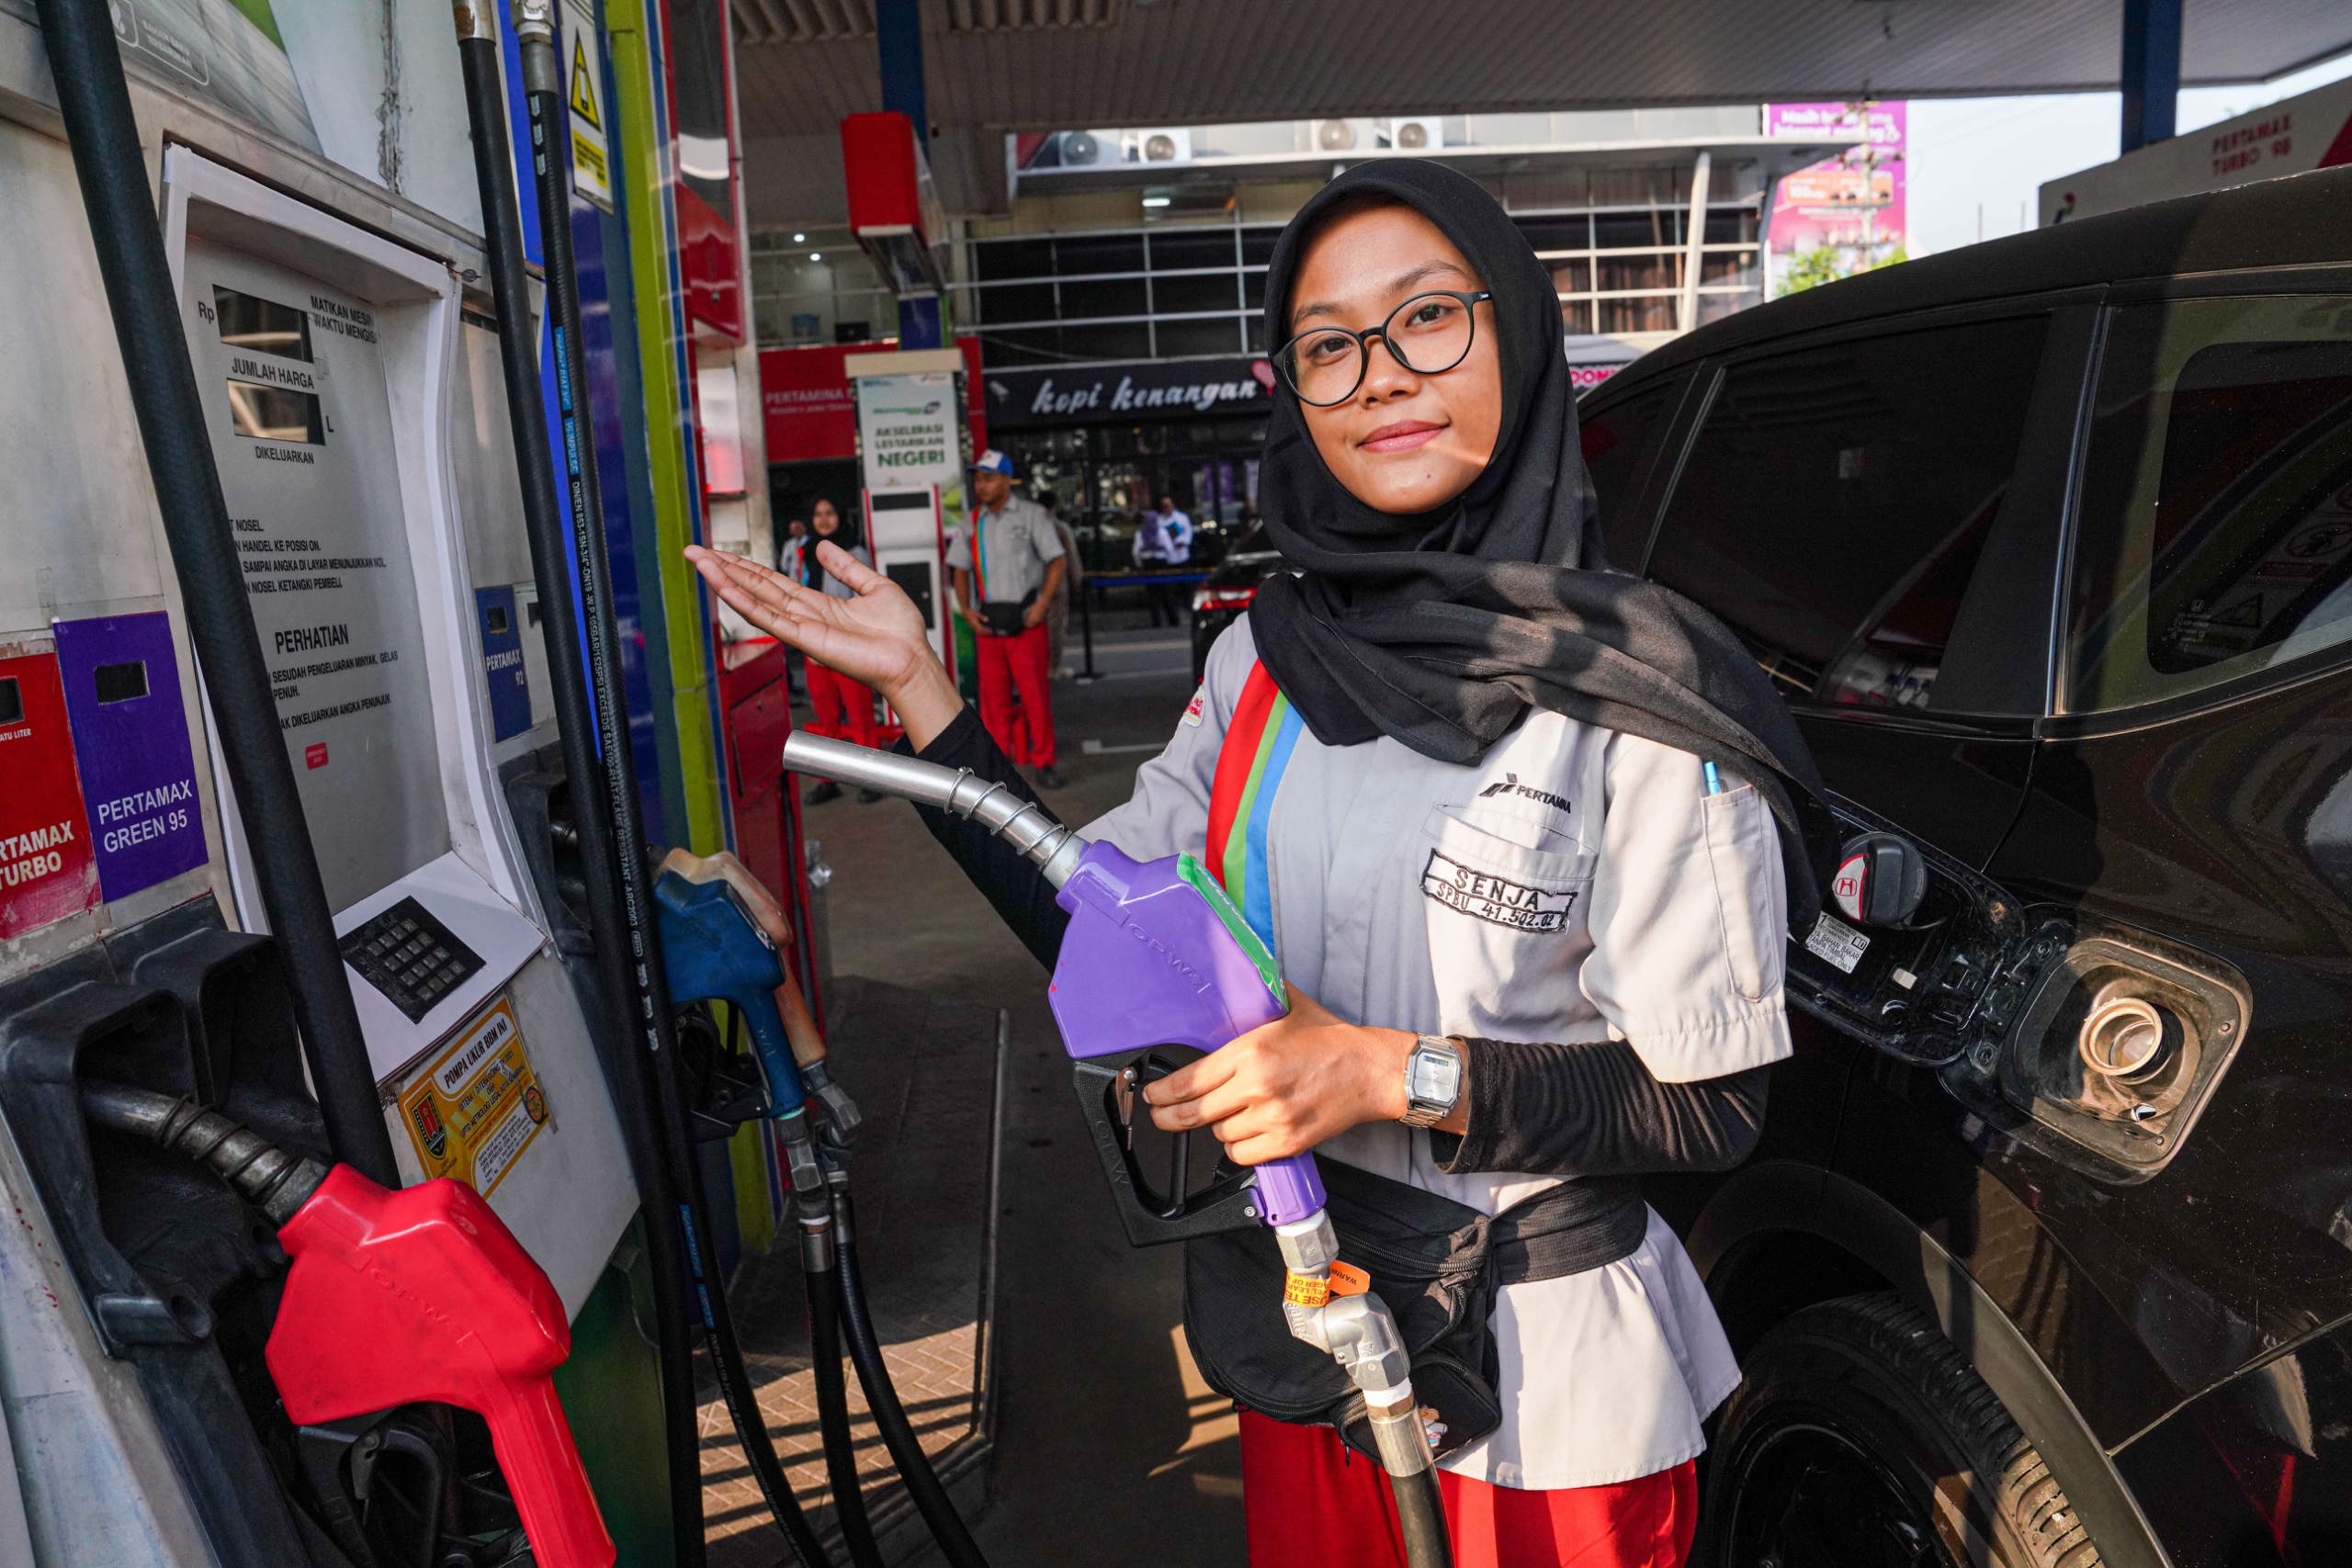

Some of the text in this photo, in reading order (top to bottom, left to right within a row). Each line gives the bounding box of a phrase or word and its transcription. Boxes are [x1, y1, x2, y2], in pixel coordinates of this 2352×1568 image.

[2212, 113, 2291, 154] PERTAMAX
[2212, 147, 2260, 176] TURBO
[198, 301, 215, 323] Rp
[311, 295, 349, 320] MATIKAN
[314, 313, 344, 334] WAKTU
[232, 357, 314, 389] JUMLAH HARGA
[1031, 375, 1257, 413] kopi kenangan
[325, 415, 334, 432] L
[254, 446, 314, 464] DIKELUARKAN
[877, 450, 944, 468] NEGERI
[236, 519, 265, 531] NOSEL.
[243, 540, 273, 551] HANDEL
[274, 540, 284, 551] KE
[286, 540, 308, 551] POSISI
[310, 540, 321, 551] ON.
[243, 558, 387, 573] SAMPAI ANGKA DI LAYAR MENUNJUKKAN NOL.
[252, 581, 277, 593] NOSEL
[278, 579, 312, 592] KETANGKI
[275, 624, 349, 654] PERHATIAN
[273, 667, 307, 683] SESUDAH
[308, 658, 355, 677] PENGELUARAN
[355, 654, 378, 668] MINYAK,
[380, 650, 398, 663] GELAS
[486, 649, 522, 672] PERTAMAX
[514, 671, 524, 685] 92
[273, 685, 300, 701] PENUH.
[292, 706, 339, 728] DIKELUARKAN
[340, 700, 361, 715] ANGKA
[362, 694, 390, 709] PENUNJUK
[0, 728, 31, 741] ATU LITER
[597, 688, 610, 730] EXCEEDS
[616, 829, 631, 880] RESISTANT
[97, 779, 192, 825] PERTAMAX
[104, 808, 187, 852] GREEN 95
[1455, 868, 1538, 910] SENJA
[1436, 883, 1555, 927] SPBU 41.502.02
[1817, 923, 1849, 944] RECOMMENDED
[1806, 942, 1852, 972] EADED FUEL ONLY
[1809, 935, 1847, 961] TANPA TIMBAL
[1821, 934, 1840, 949] BAHAN
[1841, 946, 1860, 961] BAKAR
[443, 1017, 507, 1089] POMPA UKUR BBM INI
[458, 1092, 473, 1111] DITERA
[474, 1075, 489, 1094] DITERA
[459, 1122, 471, 1138] UPTD
[469, 1100, 491, 1127] METROLOGI
[489, 1089, 501, 1105] LEGAL
[1306, 1280, 1329, 1289] AGER
[1332, 1269, 1357, 1286] WARNI
[1286, 1292, 1300, 1303] TE
